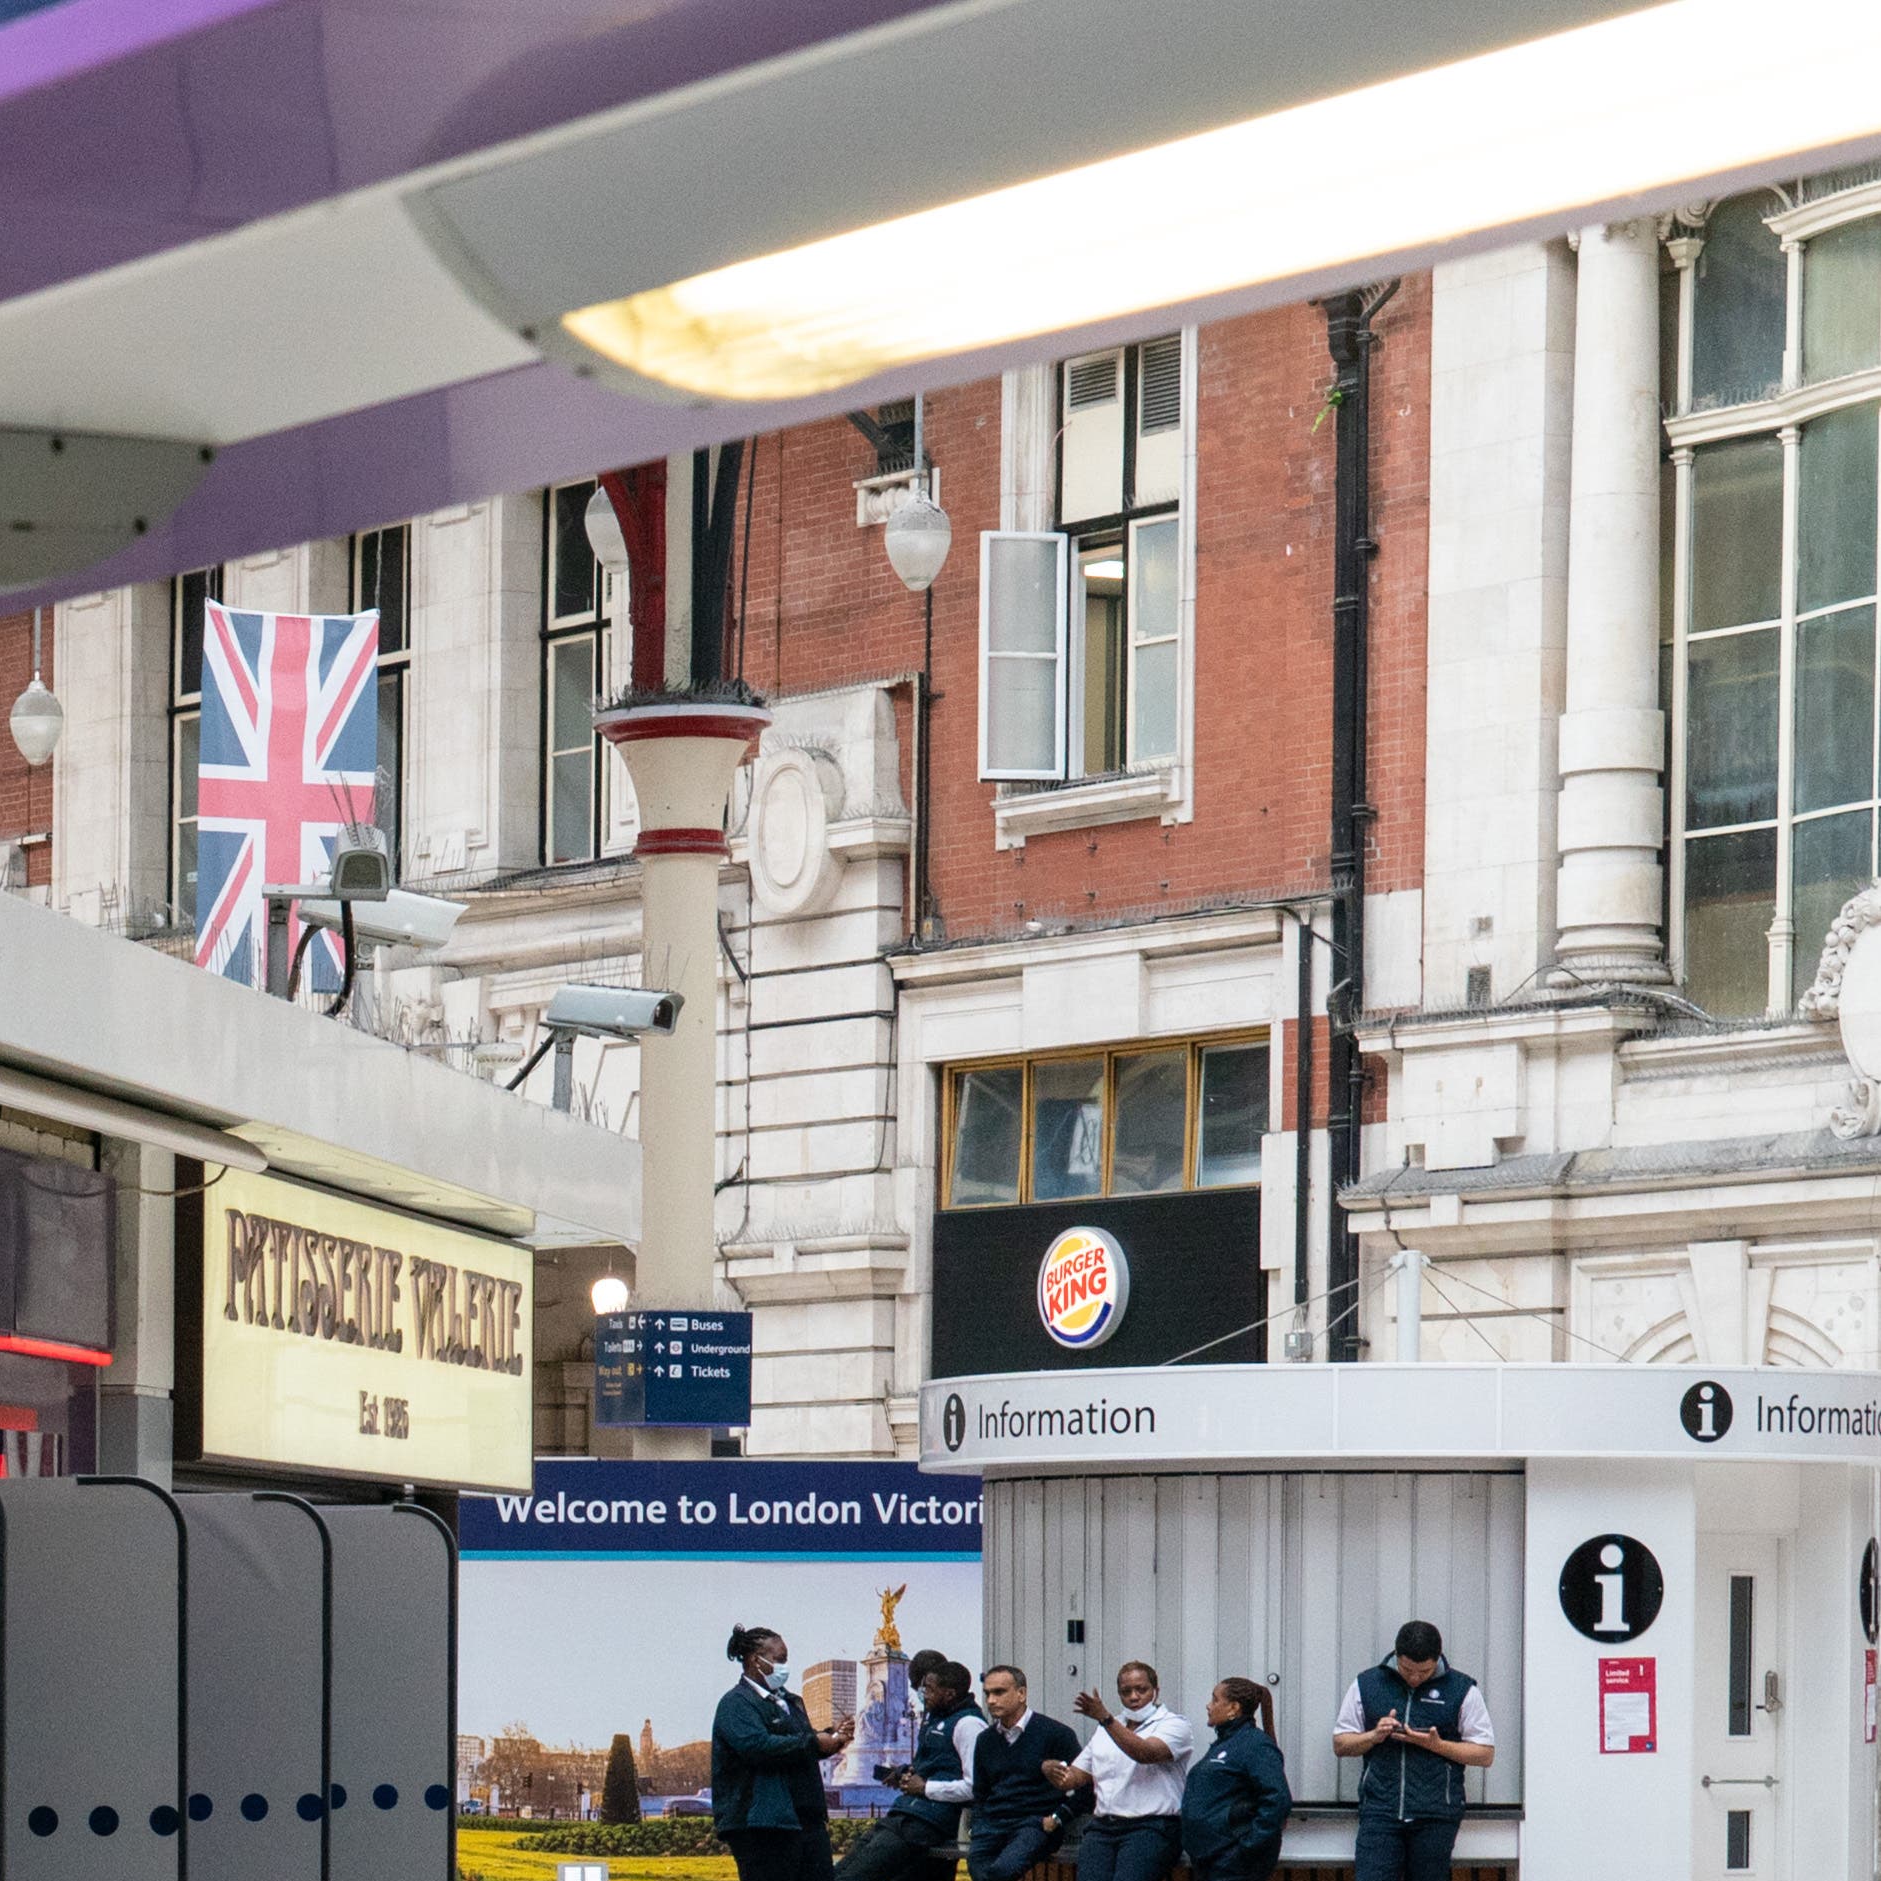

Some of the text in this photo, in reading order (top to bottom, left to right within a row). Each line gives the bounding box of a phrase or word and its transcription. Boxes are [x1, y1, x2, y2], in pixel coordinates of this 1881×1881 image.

[1046, 1247, 1104, 1293] BURGER
[224, 1208, 523, 1377] PATISSERIE VALERIE
[1049, 1266, 1107, 1322] KING
[691, 1319, 724, 1331] Buses
[691, 1343, 751, 1356] Underground
[691, 1365, 731, 1378] Tickets
[359, 1390, 381, 1435] Est
[978, 1399, 1156, 1438] Information
[1757, 1394, 1881, 1436] Informati
[495, 1493, 984, 1526] Welcome to London Victori
